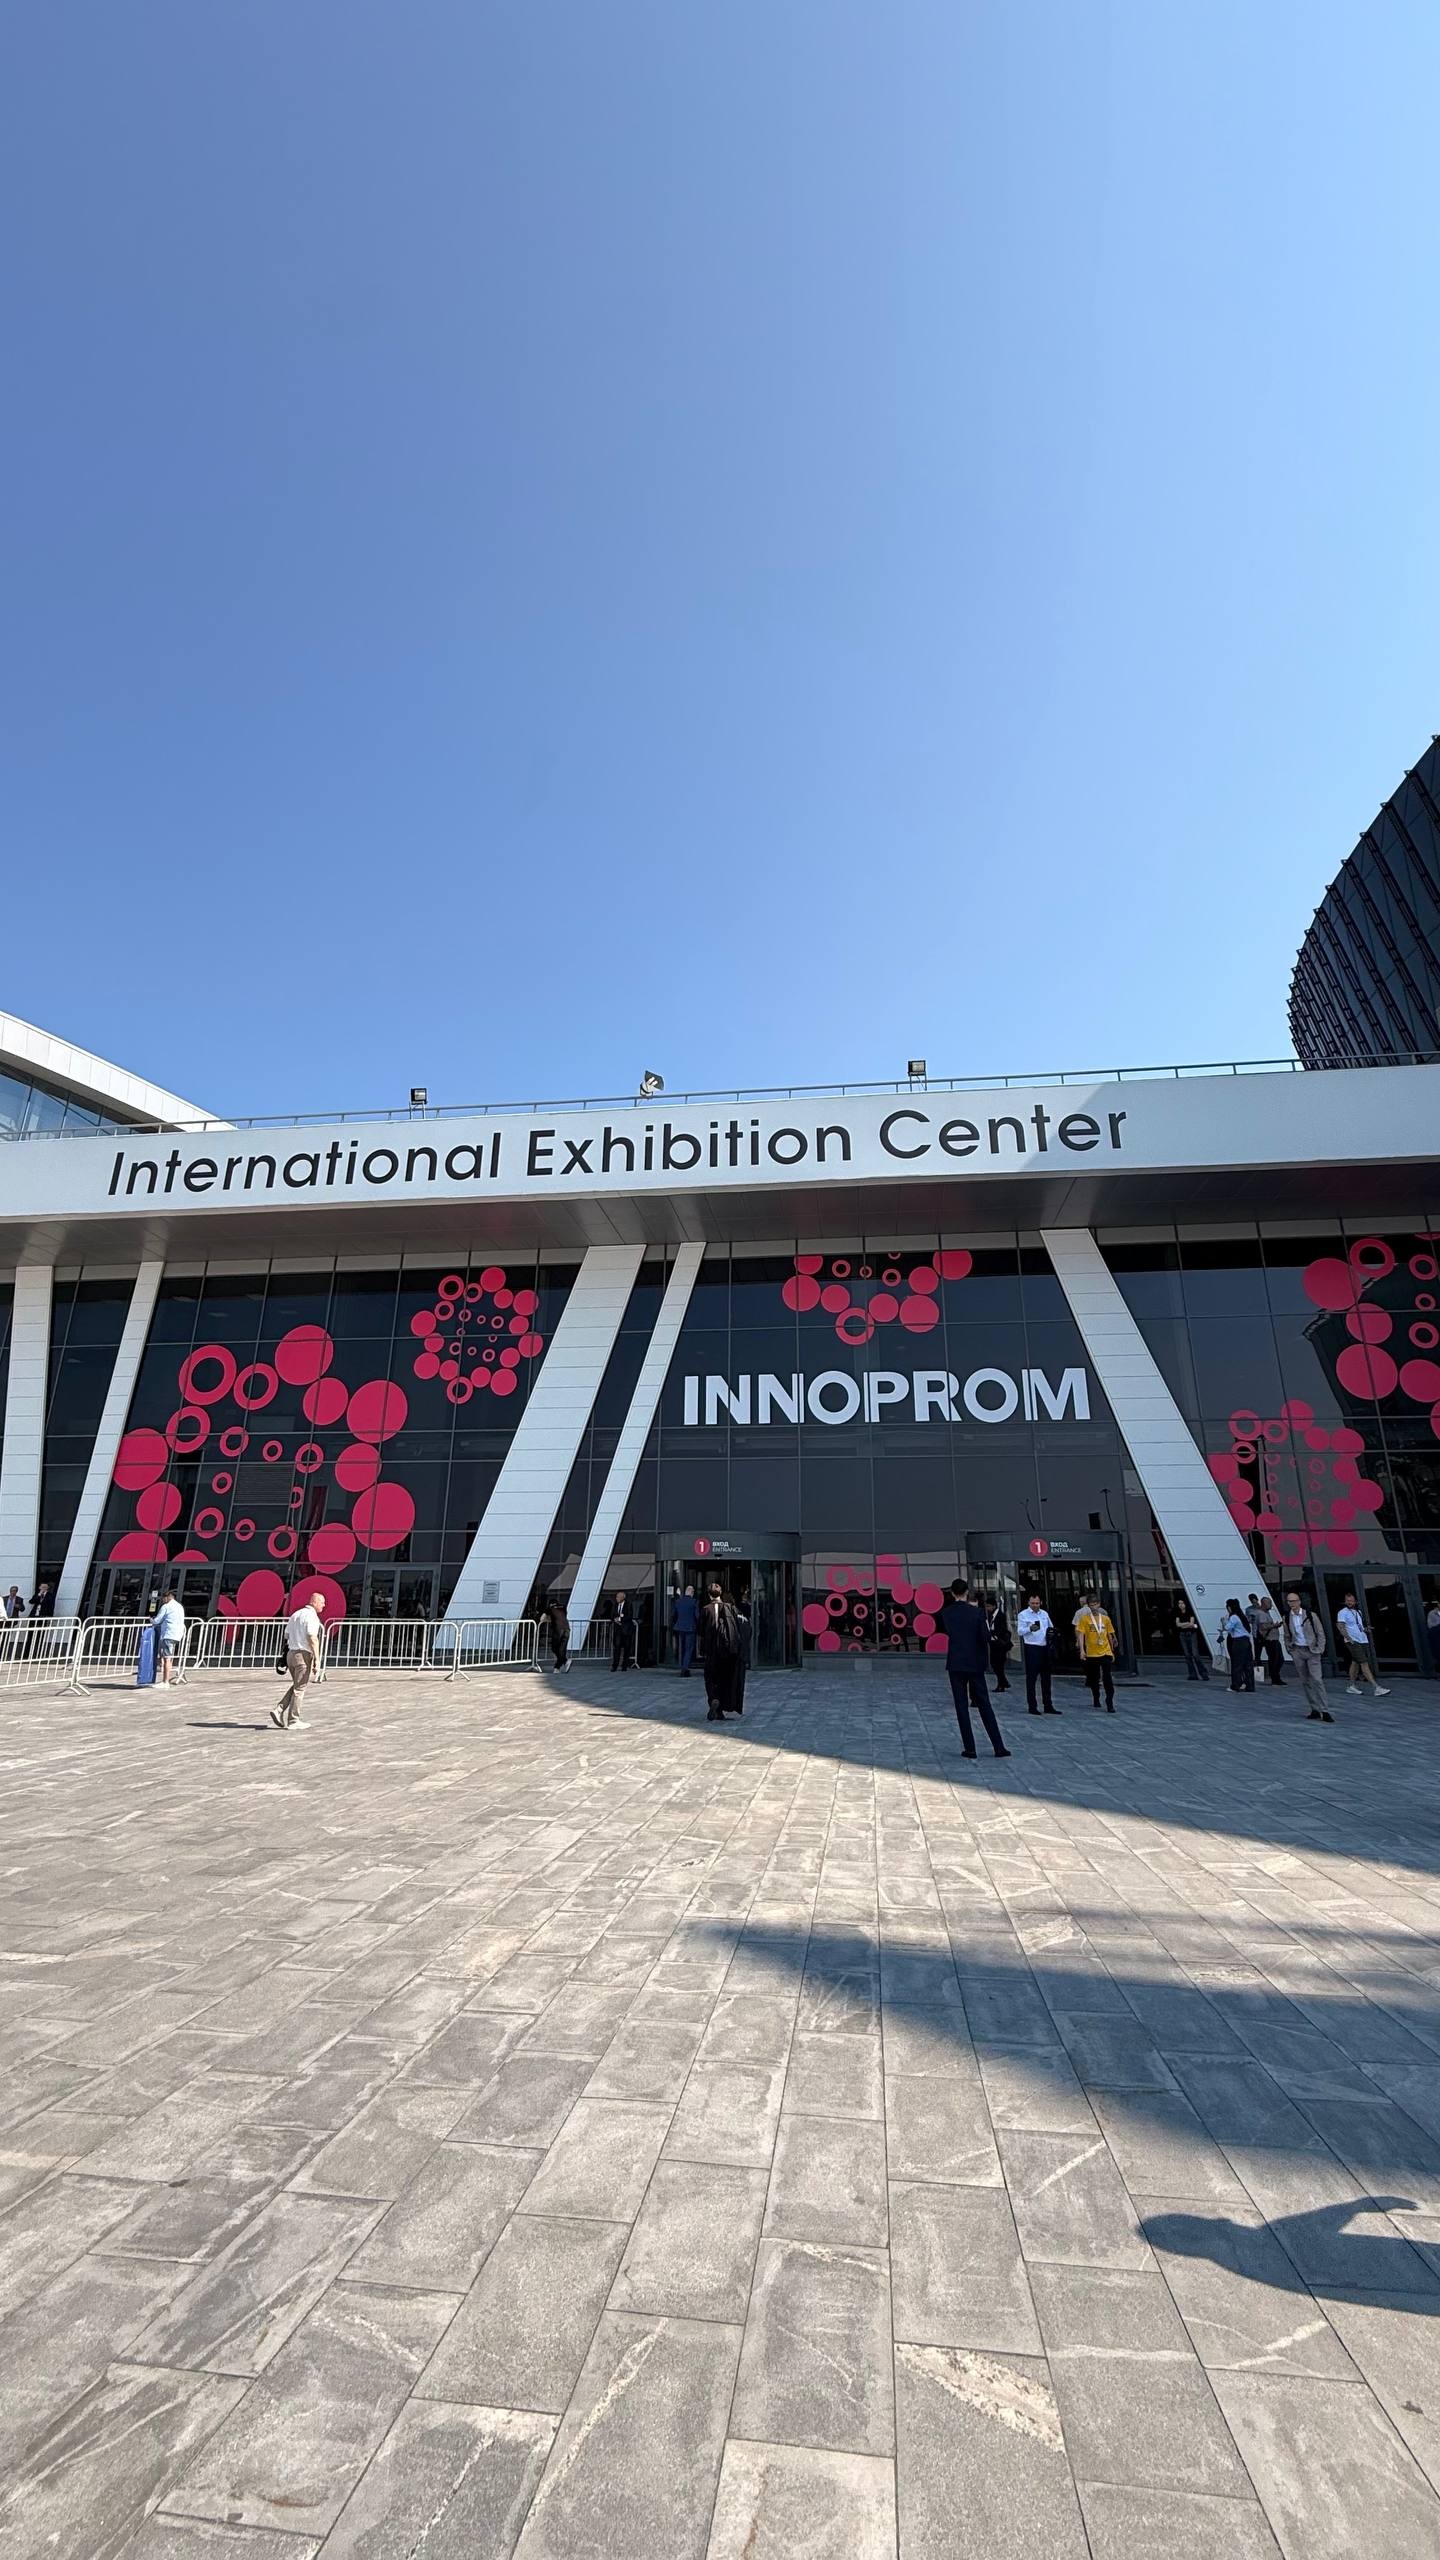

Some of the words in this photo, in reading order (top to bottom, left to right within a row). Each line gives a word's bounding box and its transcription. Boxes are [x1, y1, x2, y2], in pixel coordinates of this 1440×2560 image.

[108, 1132, 502, 1196] International
[526, 1118, 853, 1177] Exhibition
[879, 1104, 1127, 1159] Center
[683, 1368, 1092, 1426] INNOPROM
[699, 1541, 705, 1553] 1
[1035, 1541, 1042, 1553] 1
